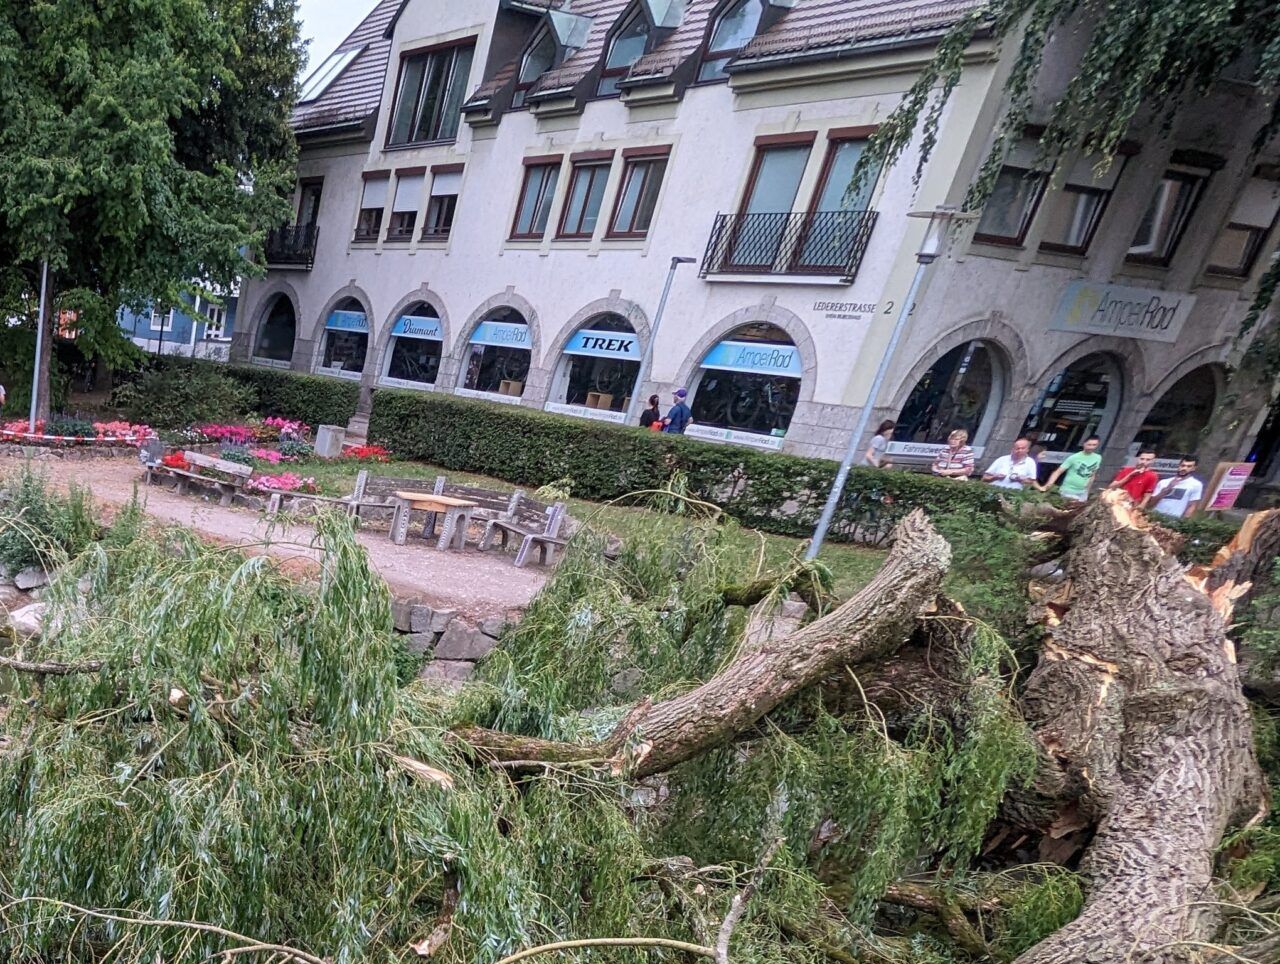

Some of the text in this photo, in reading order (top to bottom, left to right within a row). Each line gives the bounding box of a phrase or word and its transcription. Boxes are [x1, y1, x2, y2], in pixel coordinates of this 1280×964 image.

[813, 301, 894, 315] LEDERERSTRASSE 2
[1090, 290, 1181, 332] AmperRad
[403, 318, 438, 337] Diamant
[582, 336, 634, 353] TREK
[736, 347, 794, 369] AmperRad
[903, 444, 945, 454] Fahrradwer
